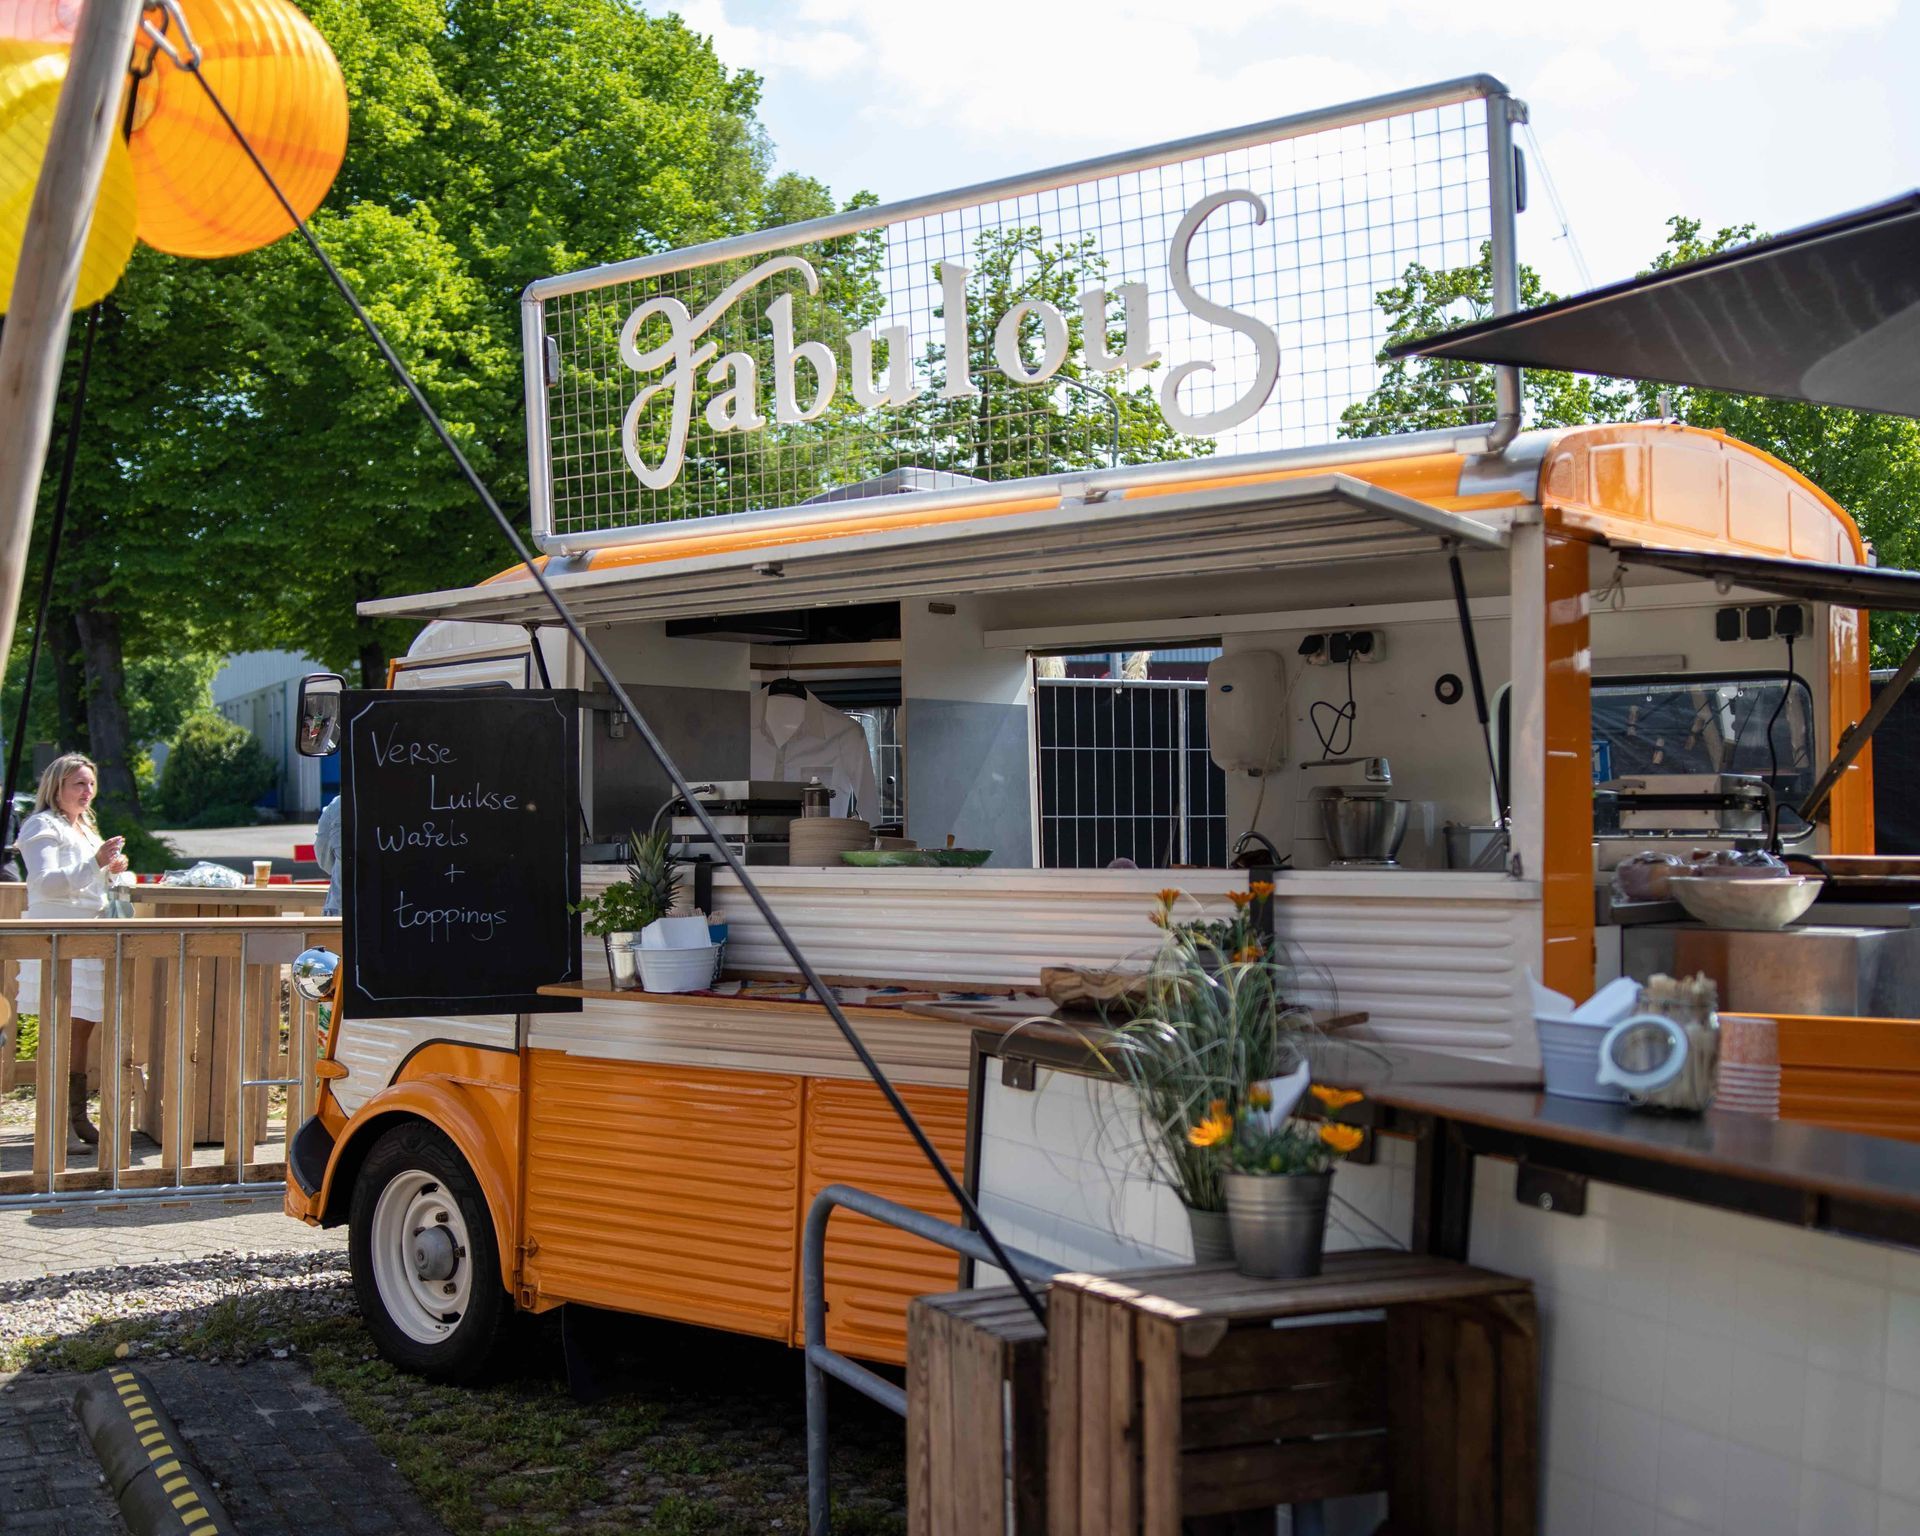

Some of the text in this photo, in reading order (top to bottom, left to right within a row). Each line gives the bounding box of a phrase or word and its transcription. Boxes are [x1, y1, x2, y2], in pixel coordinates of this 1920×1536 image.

[430, 774, 519, 811] Luikse
[443, 863, 465, 883] +
[393, 890, 508, 943] toppings
